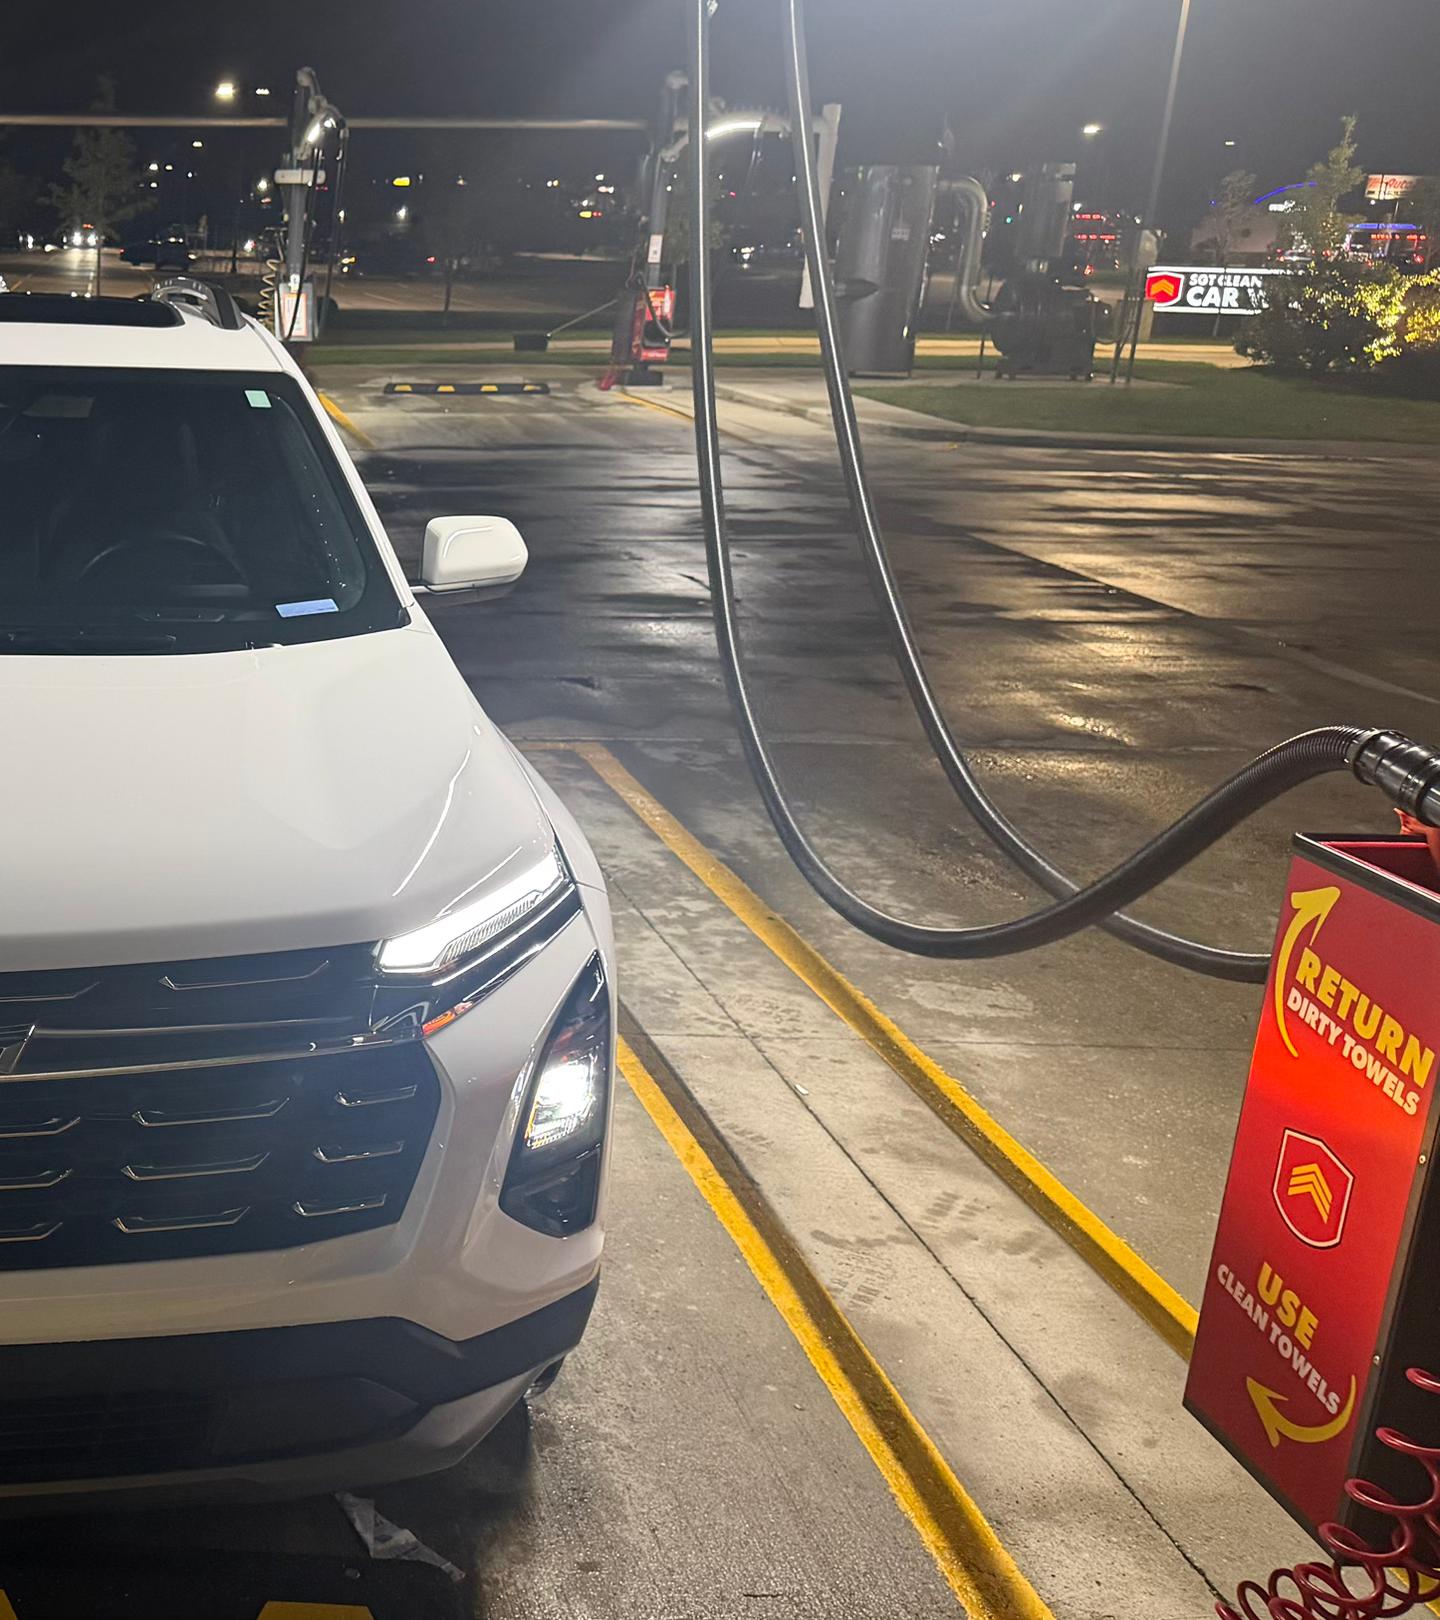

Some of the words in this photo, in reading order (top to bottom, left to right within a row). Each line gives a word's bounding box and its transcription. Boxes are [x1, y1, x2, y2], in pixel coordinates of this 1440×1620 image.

[1186, 286, 1239, 308] CAR
[1217, 274, 1262, 288] CLEAN
[1286, 986, 1342, 1046] DIRTY
[1341, 1033, 1420, 1116] TOWELS
[1295, 946, 1436, 1089] RETURN
[1217, 1264, 1270, 1332] CLEAN
[1269, 1321, 1341, 1415] TOWELS
[1257, 1261, 1320, 1351] USE
